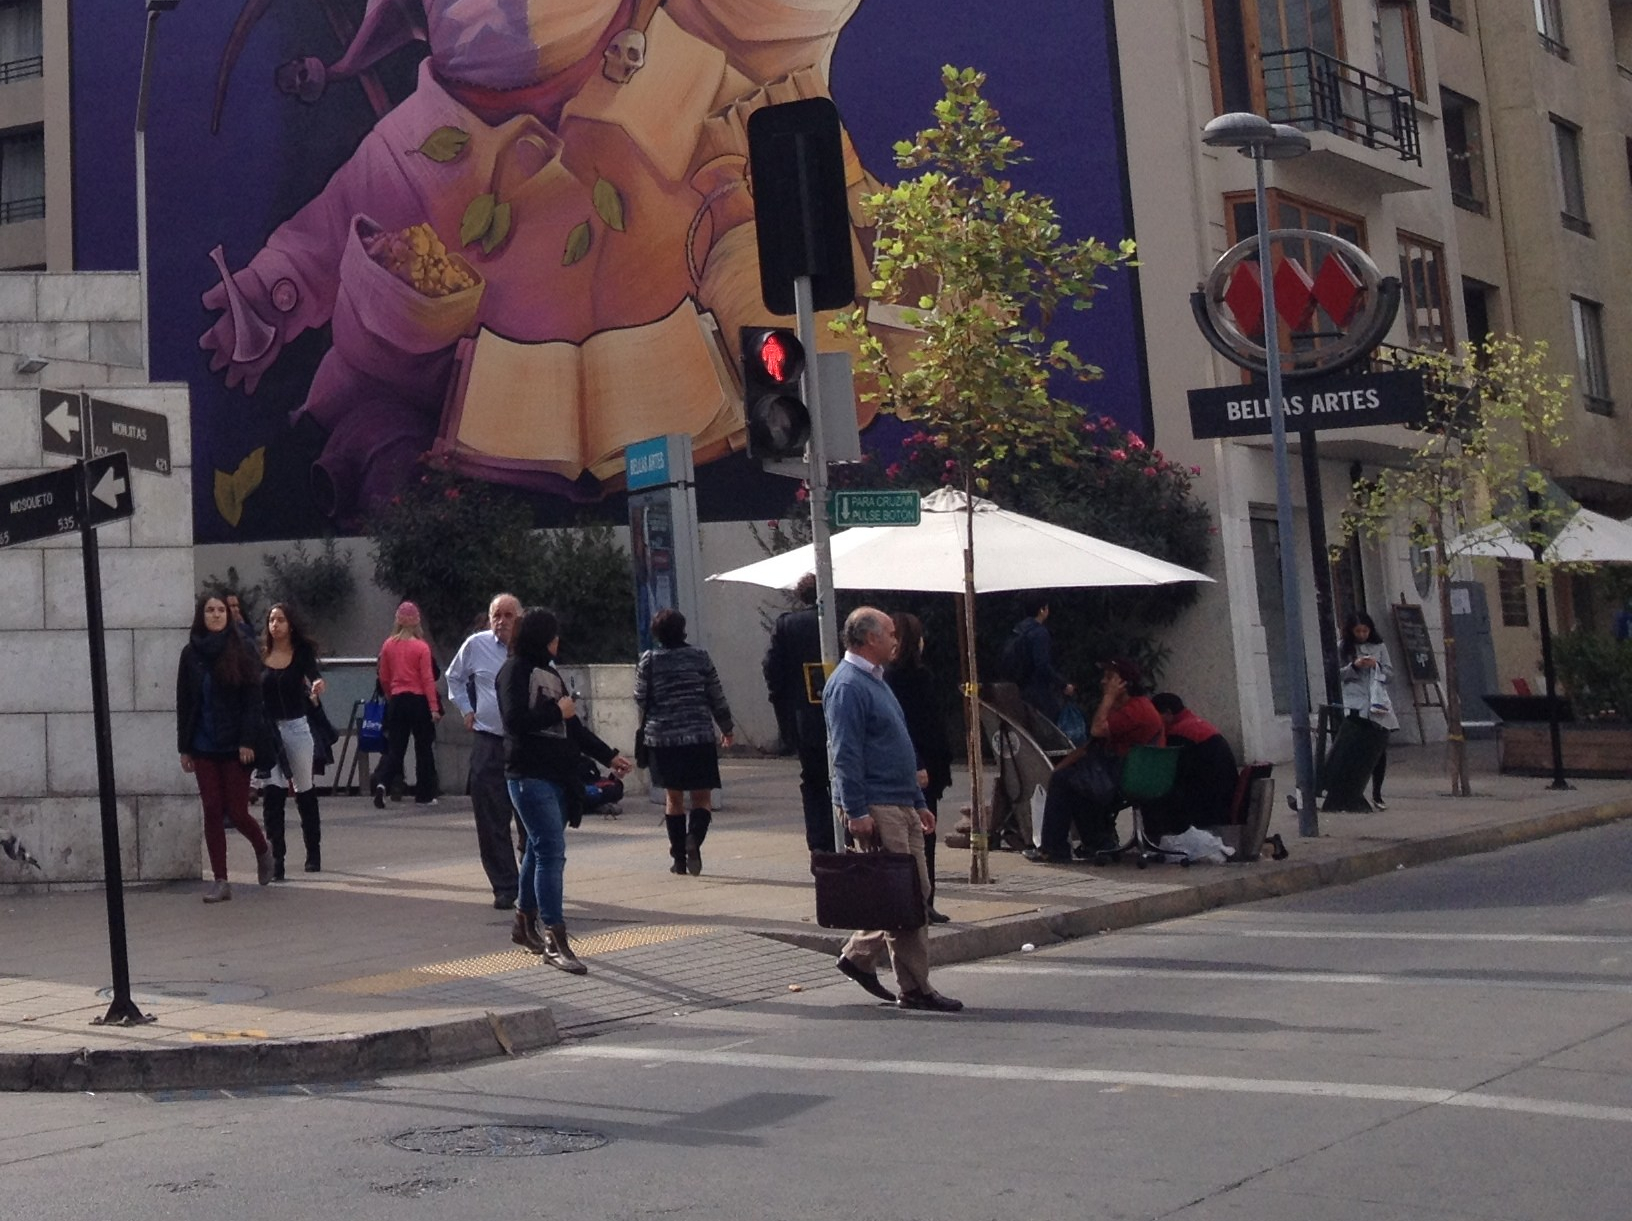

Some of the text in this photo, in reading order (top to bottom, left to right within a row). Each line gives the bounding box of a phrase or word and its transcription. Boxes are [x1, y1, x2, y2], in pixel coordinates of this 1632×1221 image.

[1311, 389, 1381, 414] ARTES
[112, 422, 147, 440] MONJITAS
[10, 493, 53, 514] MOSQUETO
[851, 495, 913, 508] PARA CRUZAR
[851, 509, 881, 521] PULSE
[58, 516, 75, 531] 535
